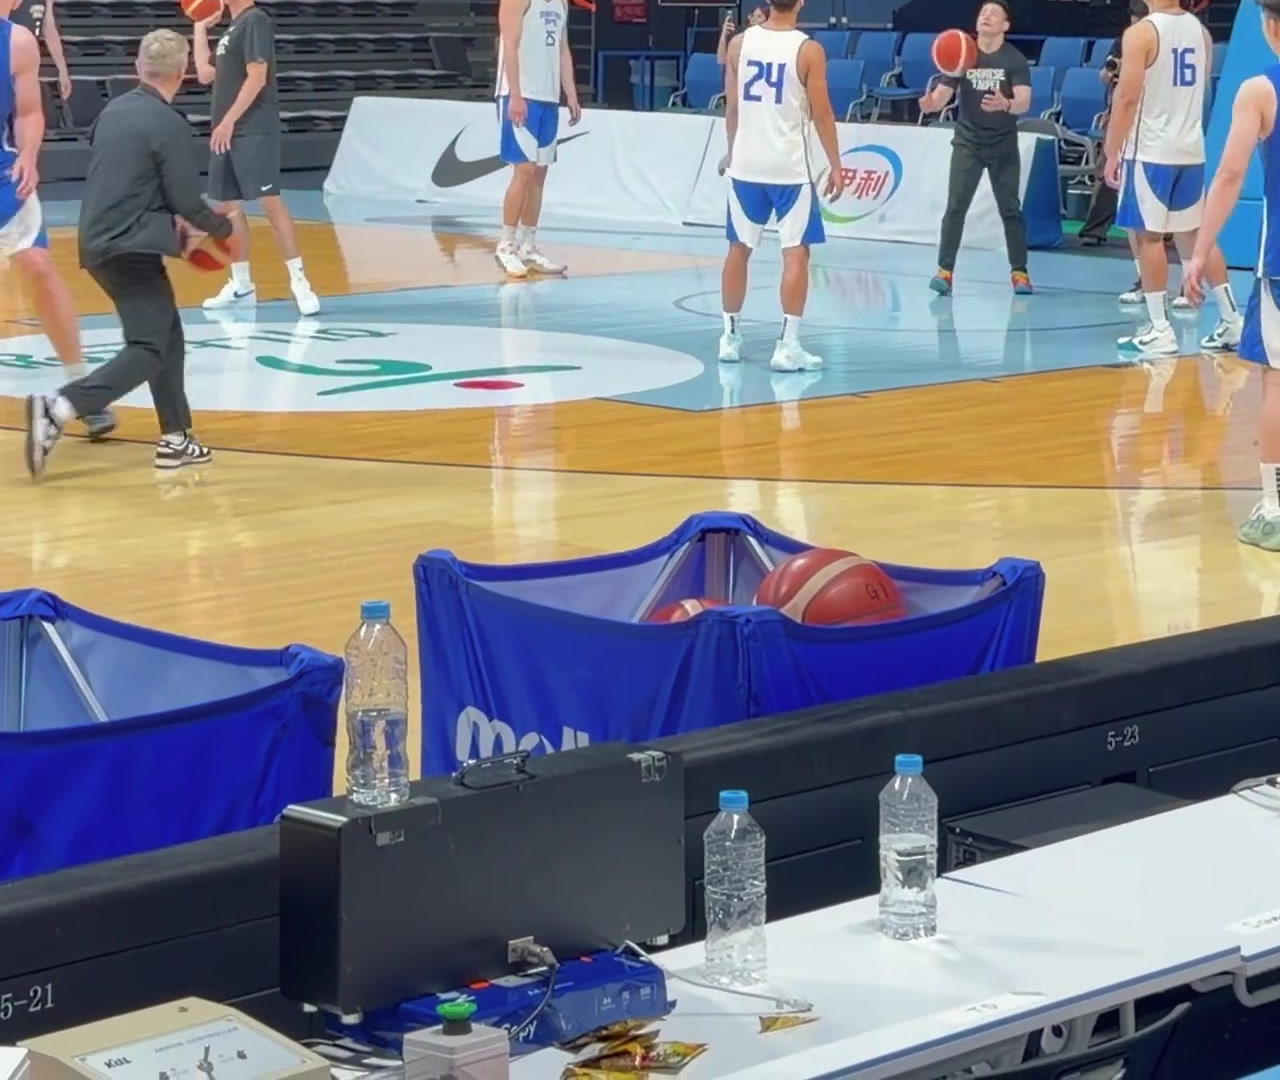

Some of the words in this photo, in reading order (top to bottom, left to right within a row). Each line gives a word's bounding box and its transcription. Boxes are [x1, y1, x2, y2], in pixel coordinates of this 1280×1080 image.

[743, 60, 787, 105] 24
[1172, 47, 1197, 87] 16
[1107, 724, 1140, 752] 5-23
[0, 983, 55, 1021] 5-21
